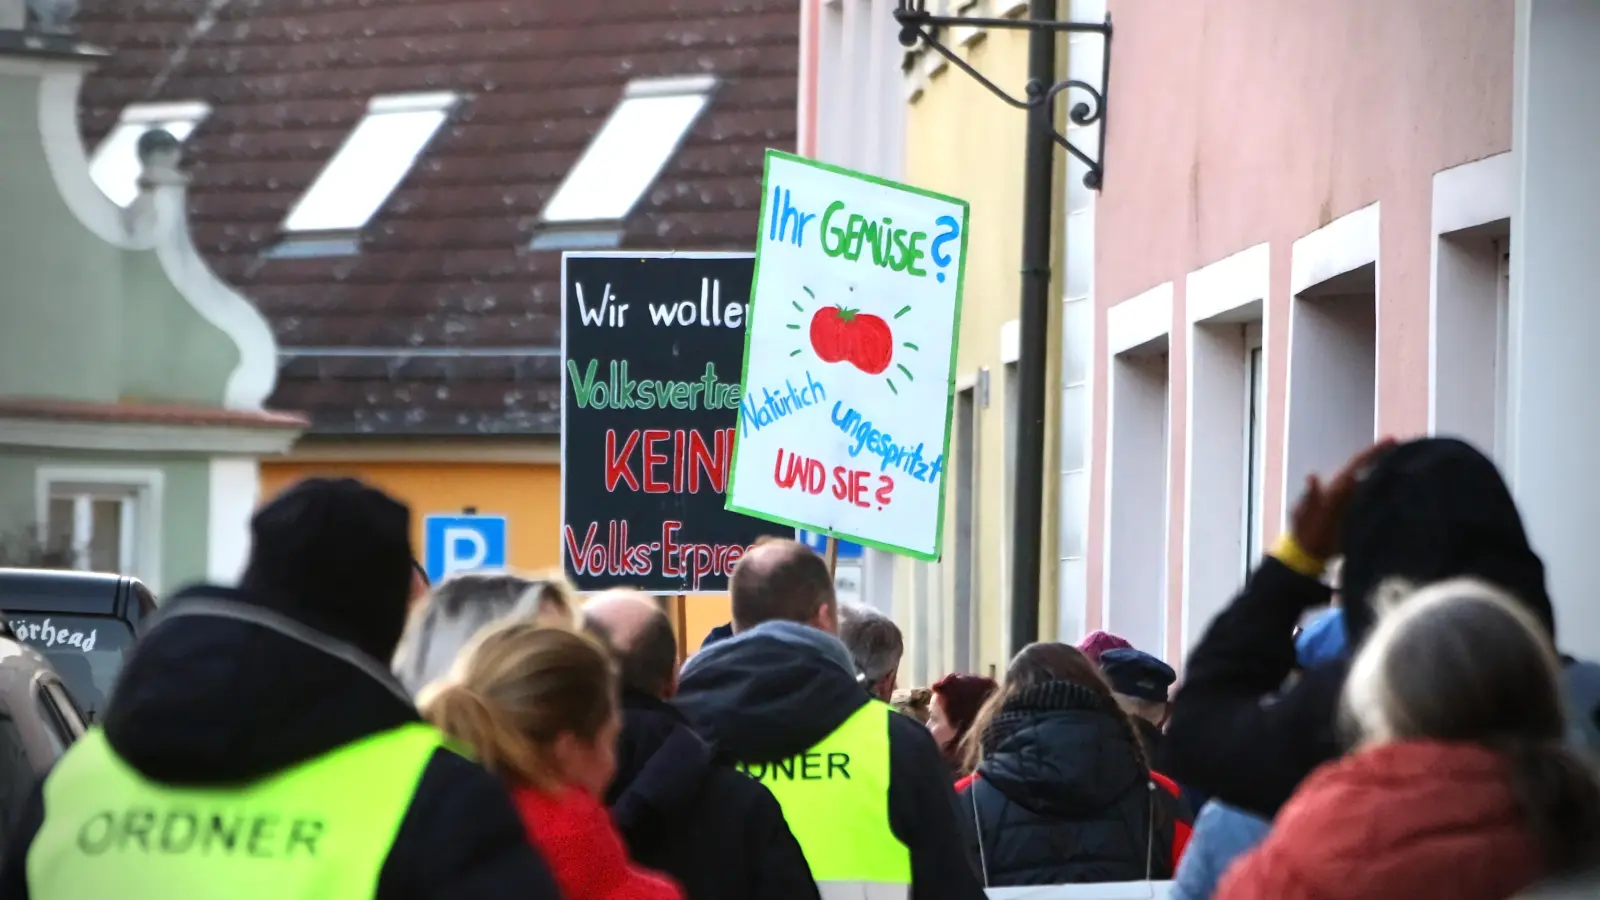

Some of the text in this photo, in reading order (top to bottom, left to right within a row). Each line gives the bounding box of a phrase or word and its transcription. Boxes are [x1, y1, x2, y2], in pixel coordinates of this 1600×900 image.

[770, 185, 816, 248] Ihr
[575, 277, 749, 328] Wir wolle
[566, 358, 742, 410] Volksvertre
[740, 370, 944, 484] Natürlich ungespritzt
[774, 448, 826, 495] UND
[444, 528, 487, 579] P
[565, 519, 757, 592] Volks-Erpre
[76, 808, 324, 858] ORDNER
